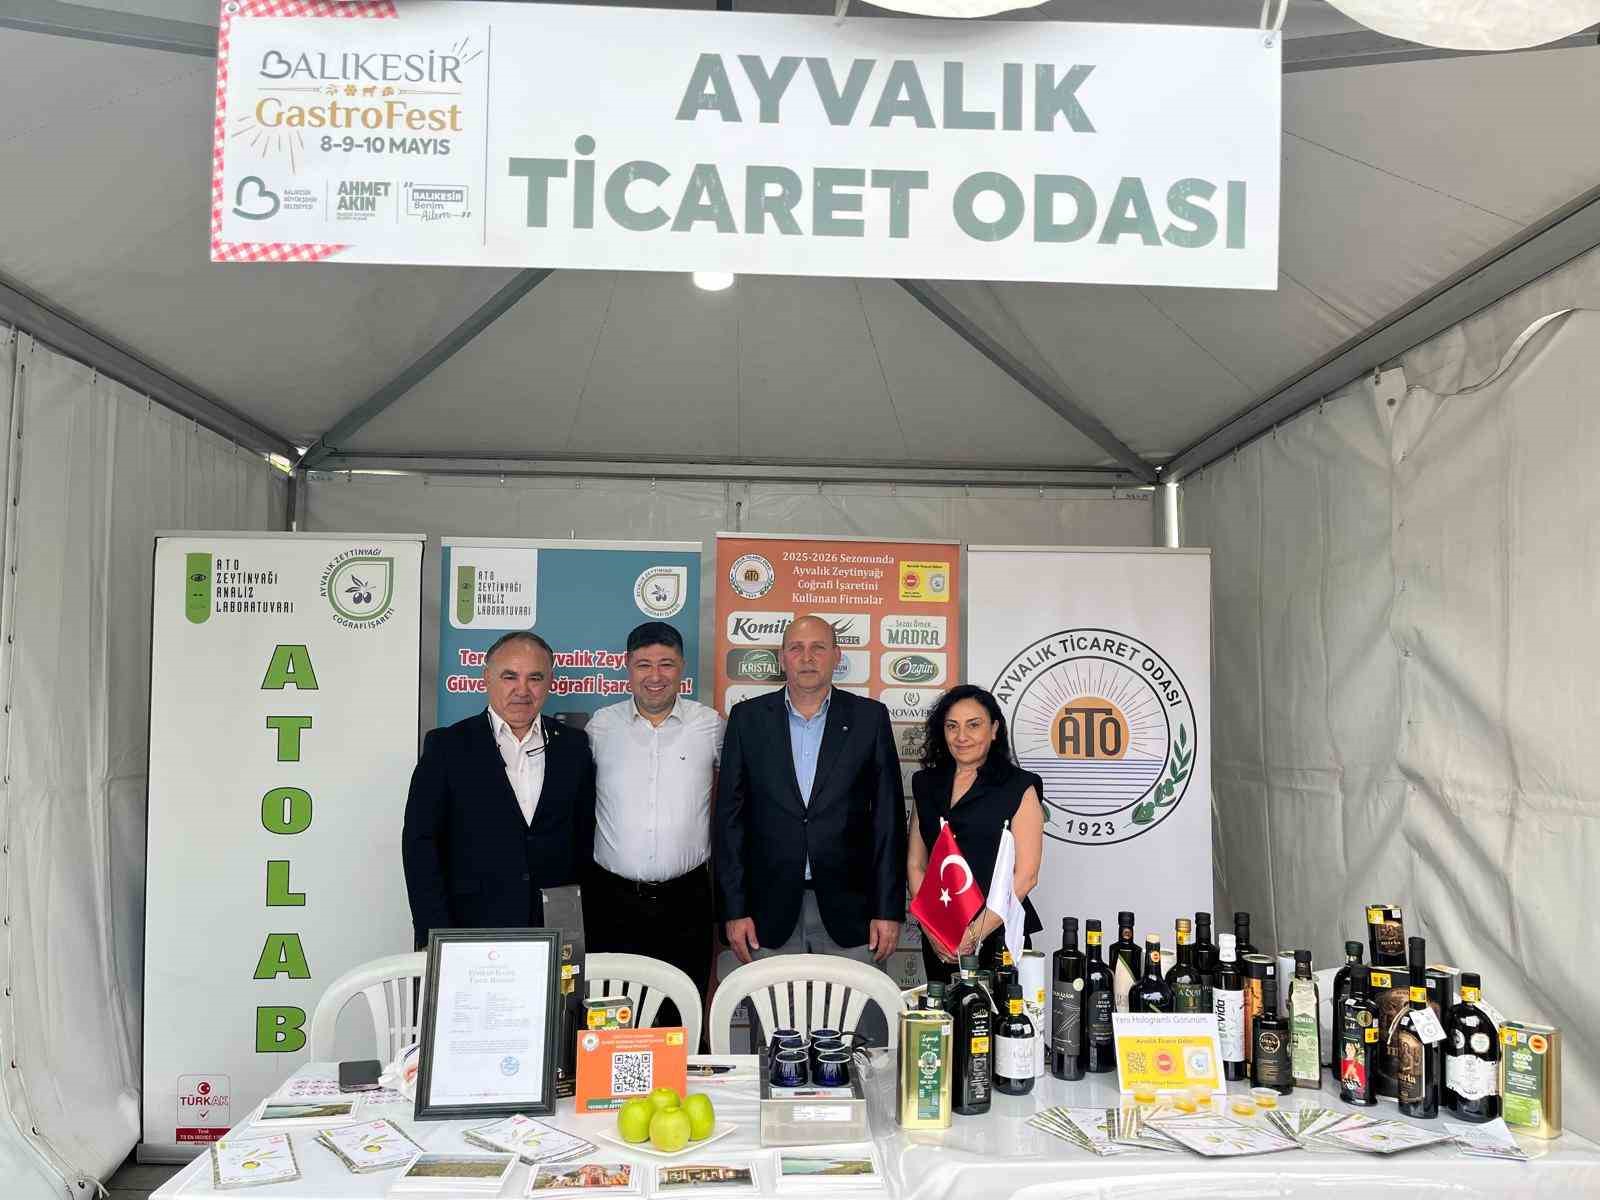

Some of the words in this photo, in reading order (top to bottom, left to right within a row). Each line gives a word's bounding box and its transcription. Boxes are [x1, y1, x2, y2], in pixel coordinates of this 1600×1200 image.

[259, 49, 462, 83] BALIKESİR
[675, 52, 1097, 133] AYVALIK
[255, 97, 463, 132] GastroFest
[320, 135, 385, 152] 8-9-10
[389, 138, 450, 155] MAYIS
[337, 181, 391, 196] AHMET
[508, 133, 929, 239] TİCARET
[952, 171, 1247, 249] ODASI
[337, 196, 376, 211] AKIN
[216, 559, 240, 570] ATO
[782, 551, 838, 562] 2025-2026
[839, 553, 895, 564] Sezonunda
[216, 570, 279, 585] ZEYTİNYAĞI
[320, 562, 336, 598] AYVALIK
[792, 566, 831, 577] Ayvalık
[832, 566, 884, 578] Zeytinyağı
[216, 586, 255, 599] ANALİZ
[798, 579, 834, 590] Coğrafi
[835, 579, 880, 592] İşaretini
[216, 600, 294, 614] LABORATUVARI
[791, 593, 837, 604] Kullanan
[839, 594, 884, 605] Firmalar
[731, 617, 791, 641] Komil
[886, 629, 941, 646] MADRA
[553, 649, 594, 668] yvalık
[741, 662, 778, 674] KRISTAL
[997, 644, 1057, 704] AYVALIK
[1058, 634, 1141, 662] TİCARET
[1141, 658, 1182, 707] ODASI
[550, 675, 594, 694] oğrafi
[1058, 707, 1121, 758] ATO
[1065, 819, 1116, 837] 1923
[253, 644, 320, 1053] ATOLAB
[180, 1094, 229, 1106] TÜRKAK
